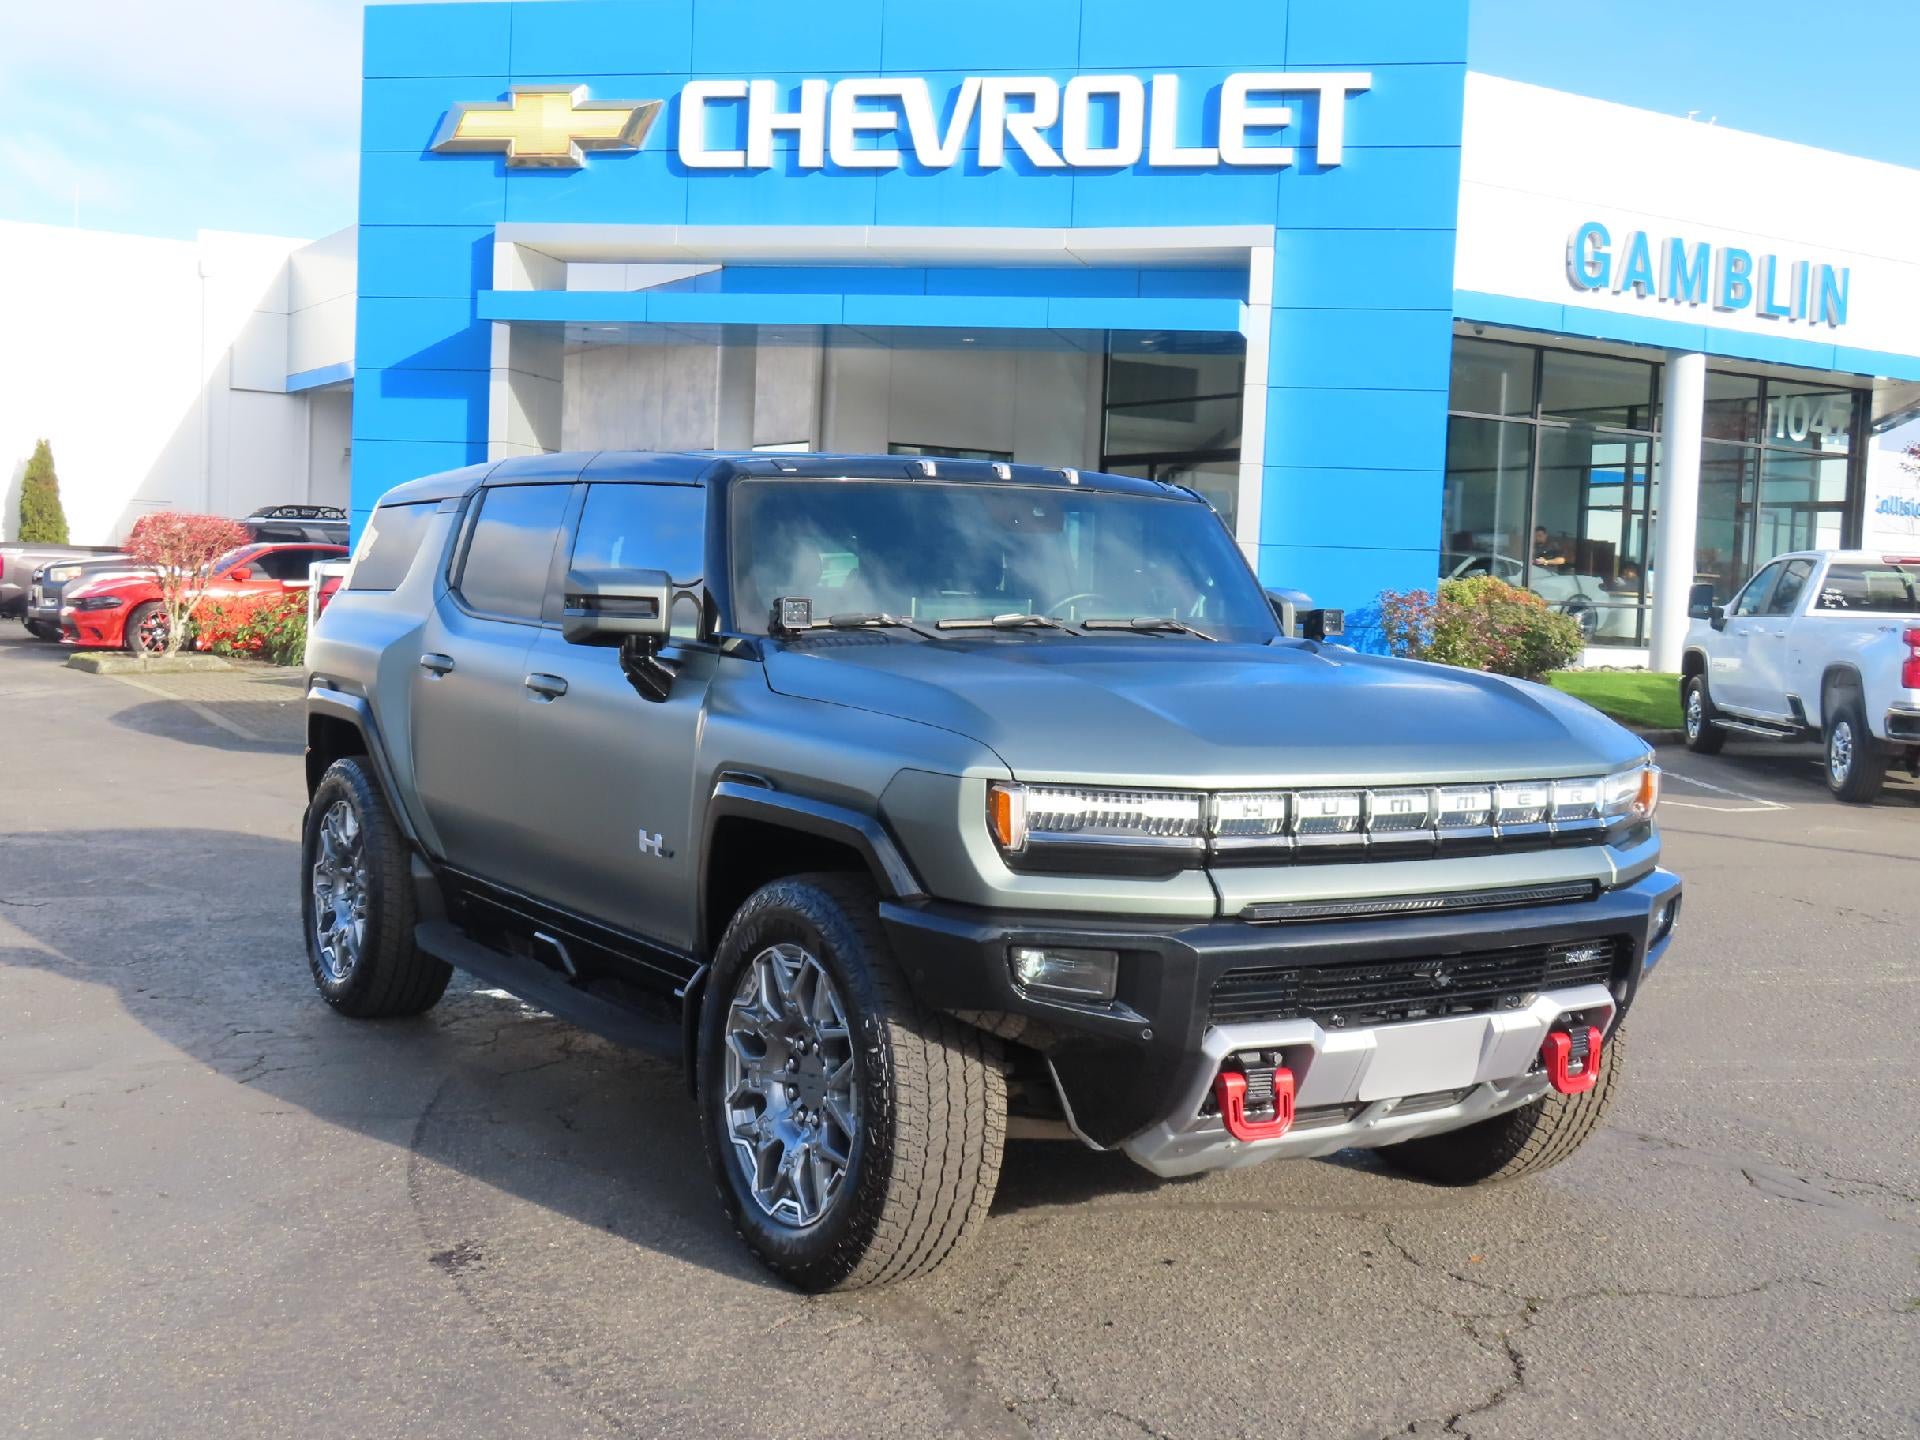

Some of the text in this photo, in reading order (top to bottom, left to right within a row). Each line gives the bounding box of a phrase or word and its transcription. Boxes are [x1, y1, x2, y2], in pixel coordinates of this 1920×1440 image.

[678, 71, 1372, 168] CHEVROLET
[1567, 221, 1850, 328] GAMBLIN
[1243, 790, 1585, 817] HUMMER
